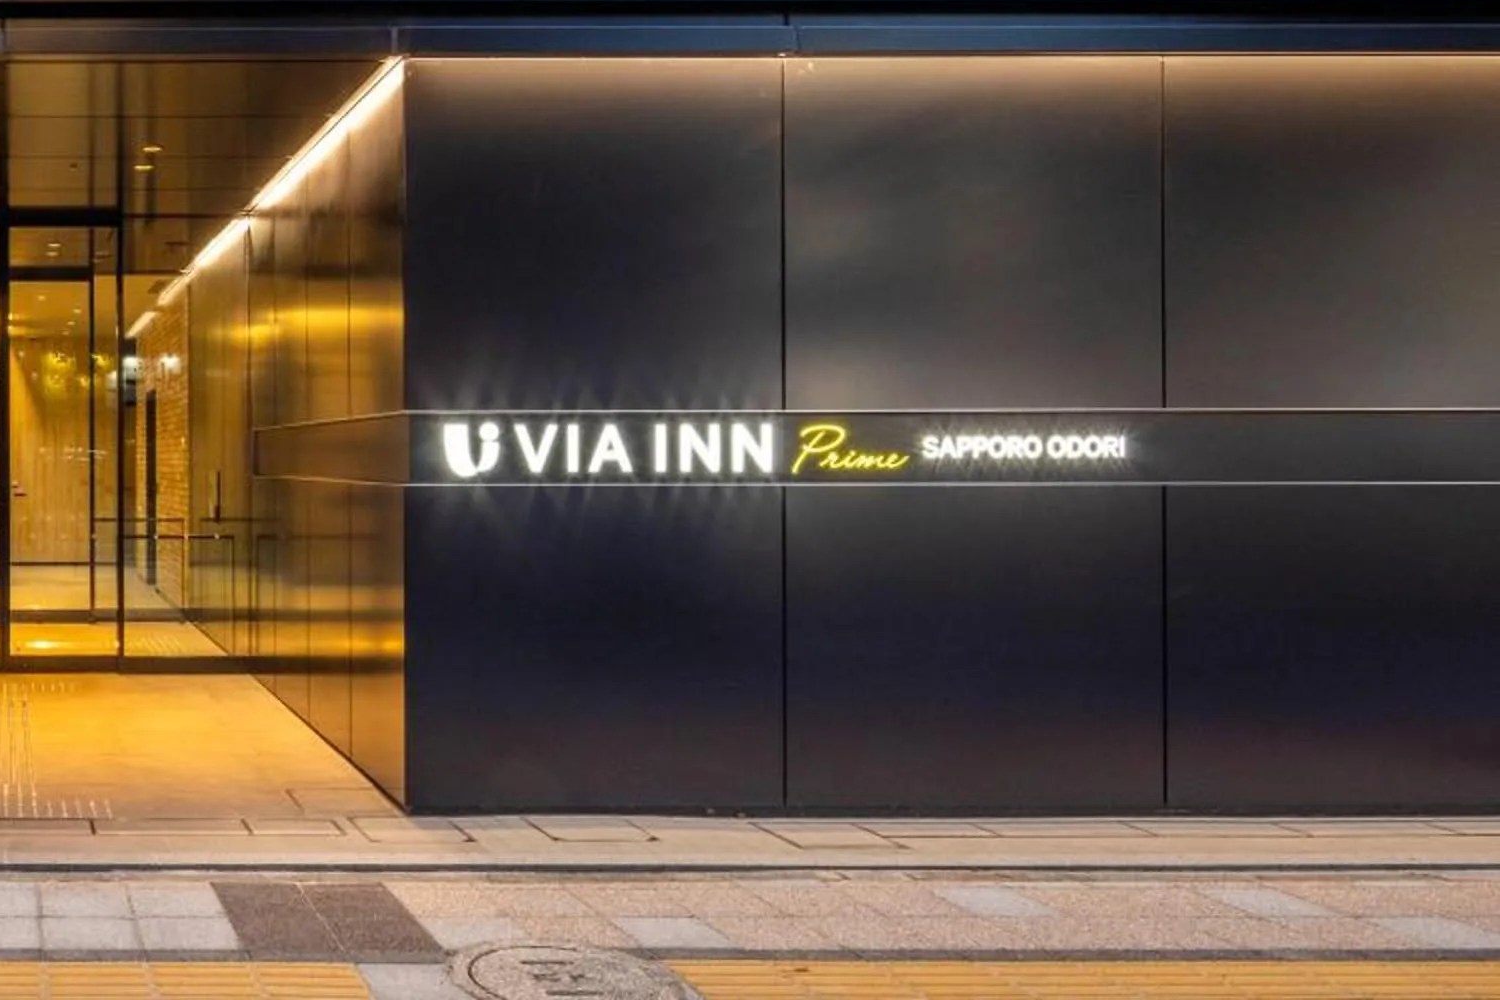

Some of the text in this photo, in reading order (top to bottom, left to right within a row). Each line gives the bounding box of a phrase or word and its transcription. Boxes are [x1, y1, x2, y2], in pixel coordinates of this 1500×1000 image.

[513, 423, 634, 474] VIA
[654, 423, 774, 474] INN
[791, 423, 910, 476] Prime
[921, 434, 1043, 460] SAPPORO
[1046, 434, 1126, 460] ODORI
